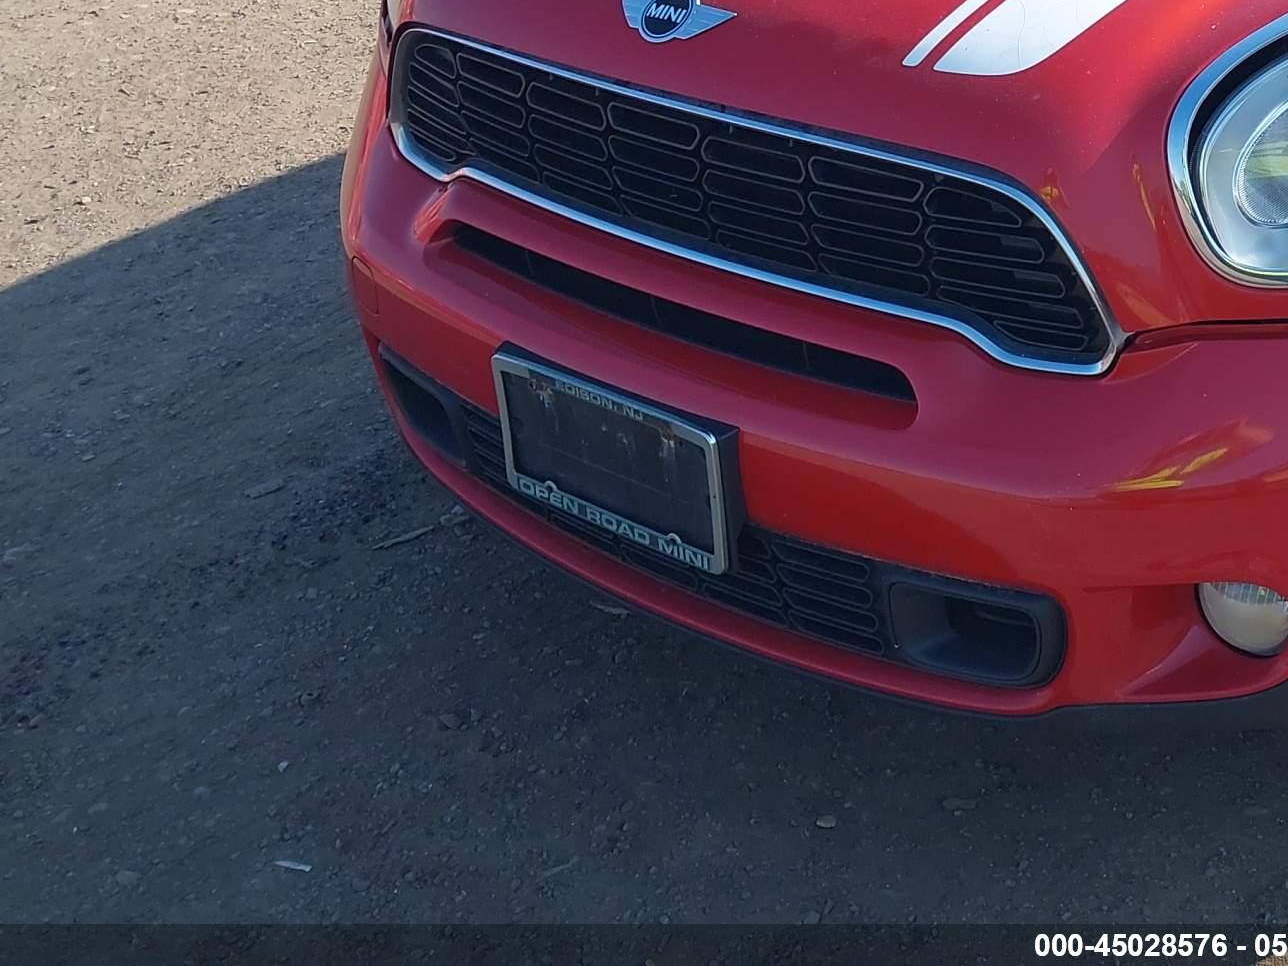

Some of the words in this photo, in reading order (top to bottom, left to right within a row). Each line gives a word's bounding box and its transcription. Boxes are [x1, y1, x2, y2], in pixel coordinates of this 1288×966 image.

[646, 2, 687, 24] MINI
[622, 406, 643, 421] NJ
[519, 476, 579, 515] OPEN
[586, 507, 650, 546] ROAD
[658, 537, 711, 571] MINI
